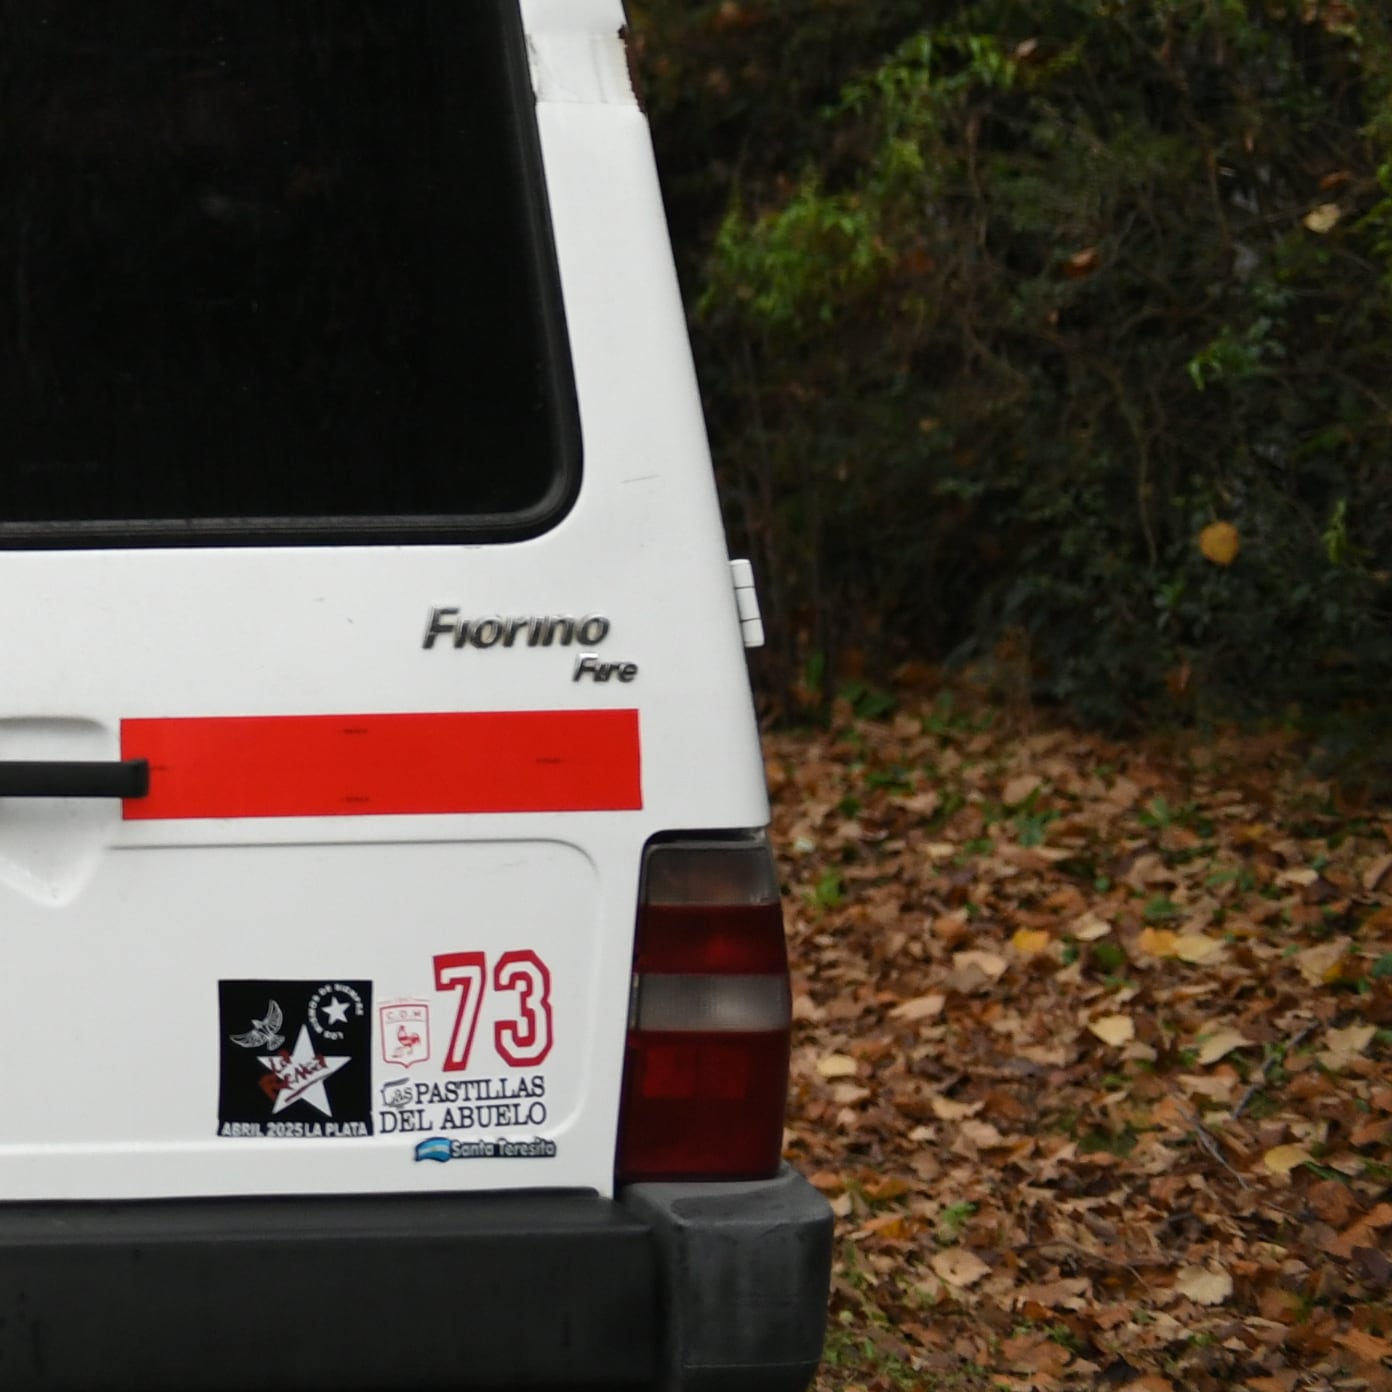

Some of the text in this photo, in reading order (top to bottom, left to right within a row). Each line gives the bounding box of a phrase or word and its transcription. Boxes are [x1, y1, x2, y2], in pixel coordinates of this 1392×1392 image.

[422, 606, 611, 650] Fiorino
[432, 949, 554, 1073] 73
[414, 1075, 546, 1105] PASTILLAS
[220, 1121, 368, 1137] ABRIL 2025 LA PLATA
[379, 1101, 548, 1134] DEL ABUELO
[451, 1137, 557, 1158] Santa Teresita
